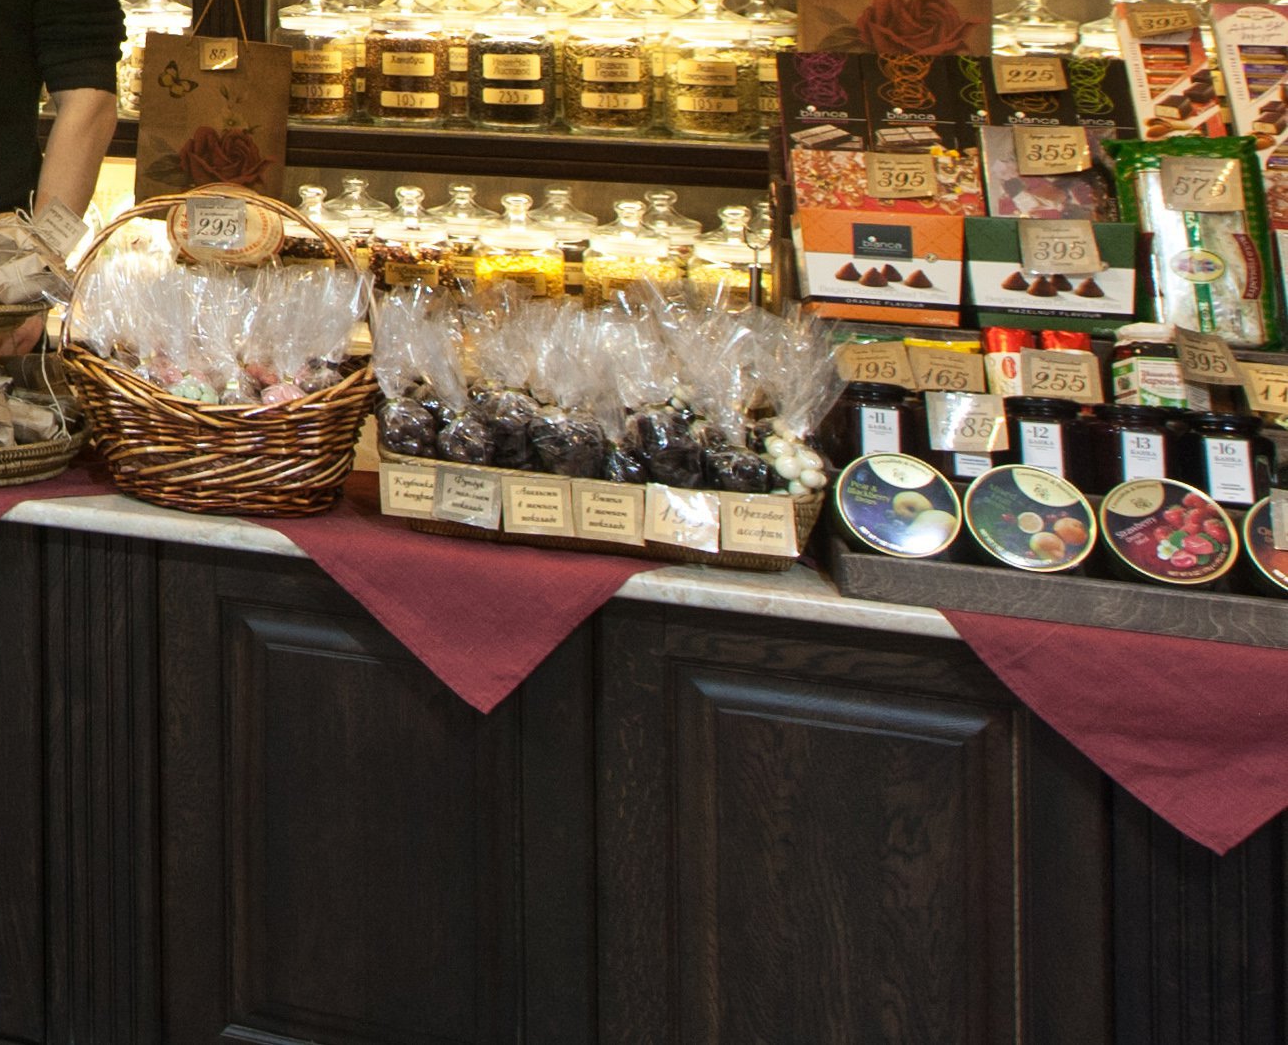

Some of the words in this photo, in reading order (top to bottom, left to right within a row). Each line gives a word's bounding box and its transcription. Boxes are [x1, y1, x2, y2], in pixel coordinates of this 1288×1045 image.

[1141, 15, 1188, 30] 395
[1006, 68, 1055, 83] 225
[800, 108, 849, 119] bianca
[886, 109, 936, 121] bianca
[1007, 113, 1060, 126] bianca
[1025, 143, 1078, 161] 355
[876, 170, 927, 188] 395
[196, 217, 239, 236] 295
[862, 238, 904, 251] bianca
[1032, 241, 1088, 261] 395
[845, 298, 881, 306] ORANGE
[884, 300, 925, 308] FLAVOUR
[1007, 307, 1056, 316] HAZELNUT
[1059, 310, 1102, 318] FLAVOUR
[853, 360, 897, 380] 195
[1185, 350, 1229, 374] 395
[921, 368, 970, 389] 165
[1031, 370, 1087, 392] 255
[1259, 384, 1288, 403] 11
[733, 505, 784, 521] Ореховое
